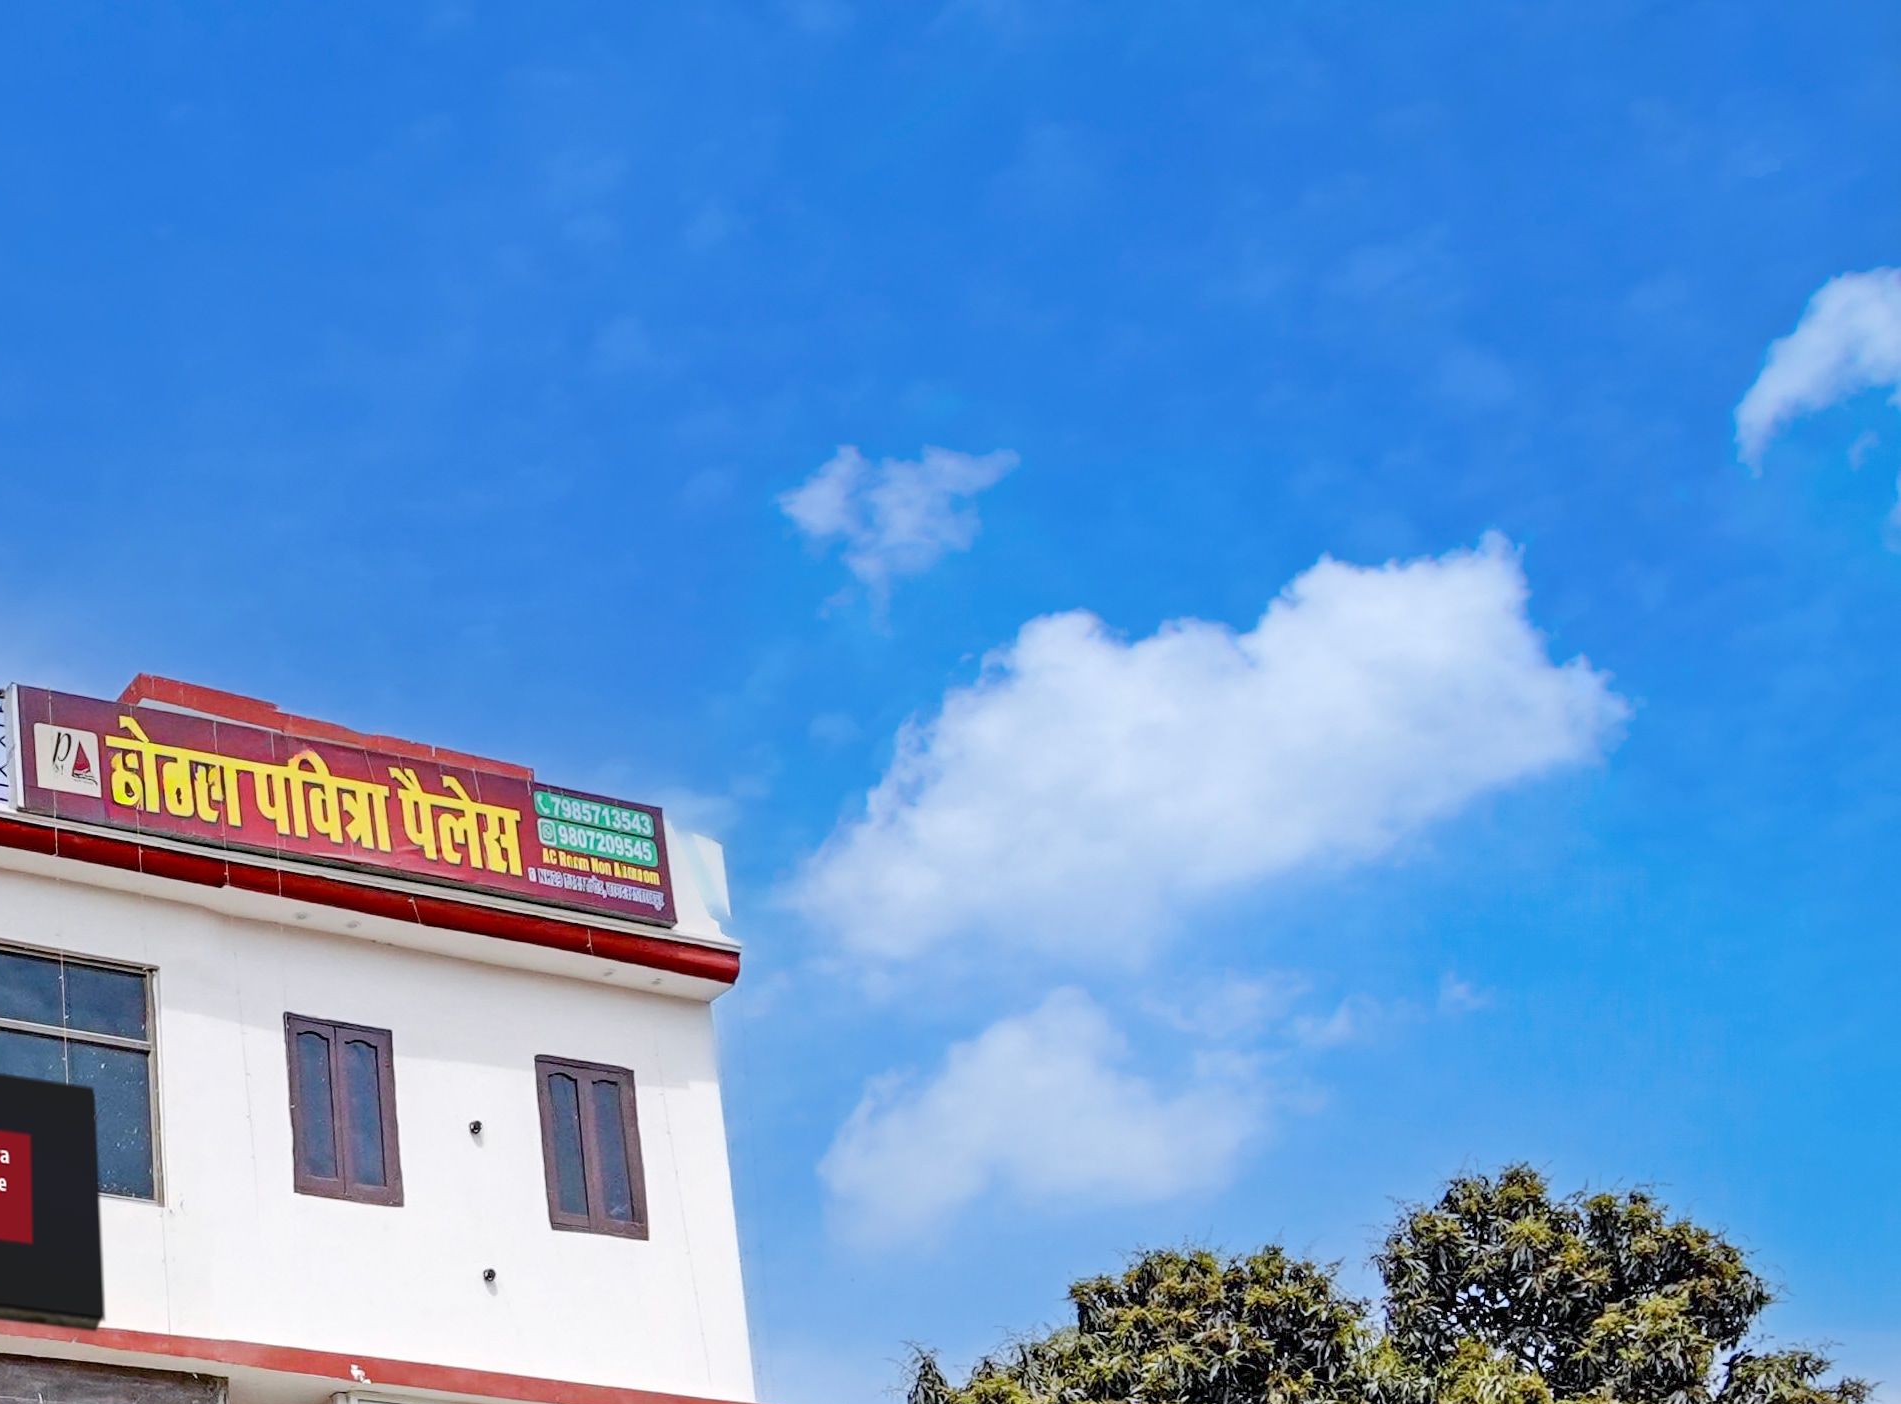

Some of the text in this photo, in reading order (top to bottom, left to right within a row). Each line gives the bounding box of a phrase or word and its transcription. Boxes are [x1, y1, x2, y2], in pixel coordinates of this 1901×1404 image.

[241, 748, 394, 854] पवित्रा
[388, 766, 524, 877] पैलेस
[551, 795, 653, 836] 7985713543
[557, 825, 655, 864] 9807209545
